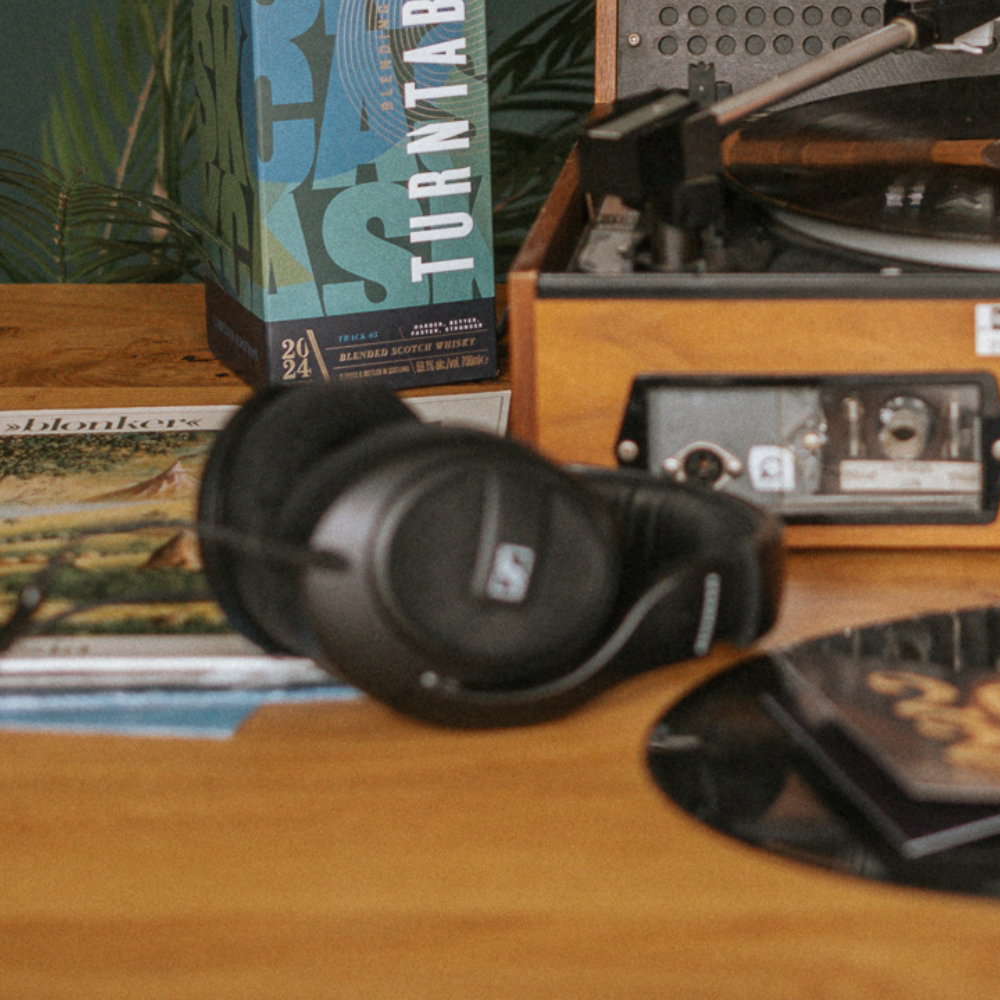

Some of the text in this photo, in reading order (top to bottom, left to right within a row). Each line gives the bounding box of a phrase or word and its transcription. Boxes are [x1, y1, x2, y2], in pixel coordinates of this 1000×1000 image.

[376, 4, 394, 111] BLENDING
[281, 337, 310, 361] 20
[337, 332, 366, 343] TRACK
[338, 336, 477, 363] BLENDED SCOTCH WHISKY
[281, 358, 313, 380] 24
